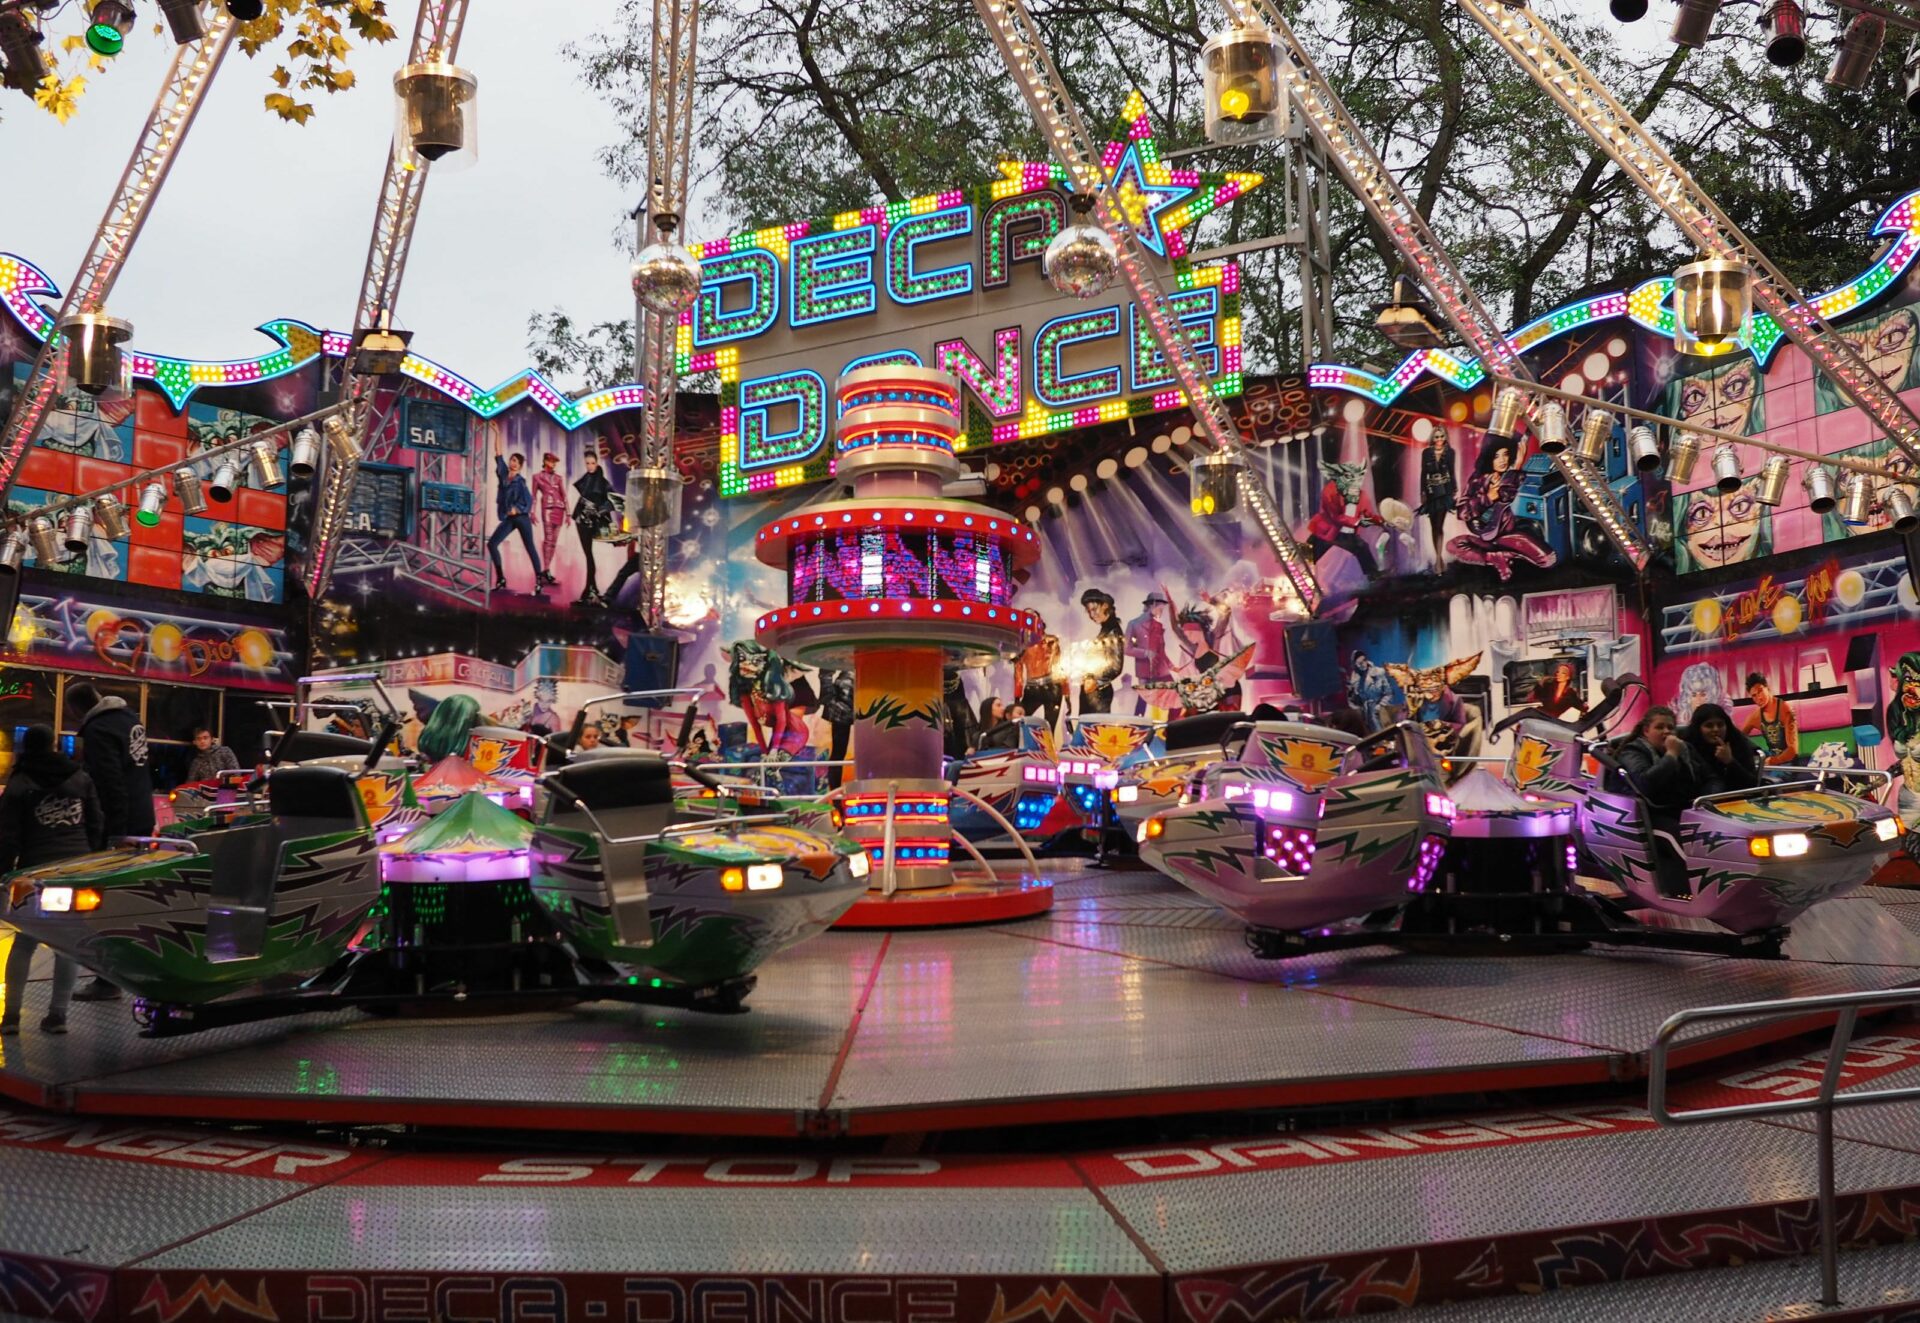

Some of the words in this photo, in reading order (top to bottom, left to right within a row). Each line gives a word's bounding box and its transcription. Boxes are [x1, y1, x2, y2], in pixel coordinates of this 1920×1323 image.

[691, 187, 1072, 348] DECA
[410, 426, 440, 446] S.A.
[1108, 734, 1117, 745] 4
[1301, 752, 1315, 768] 8
[0, 1112, 351, 1174] ANGER
[1113, 1105, 1656, 1178] DANGER
[477, 1157, 941, 1183] STOP
